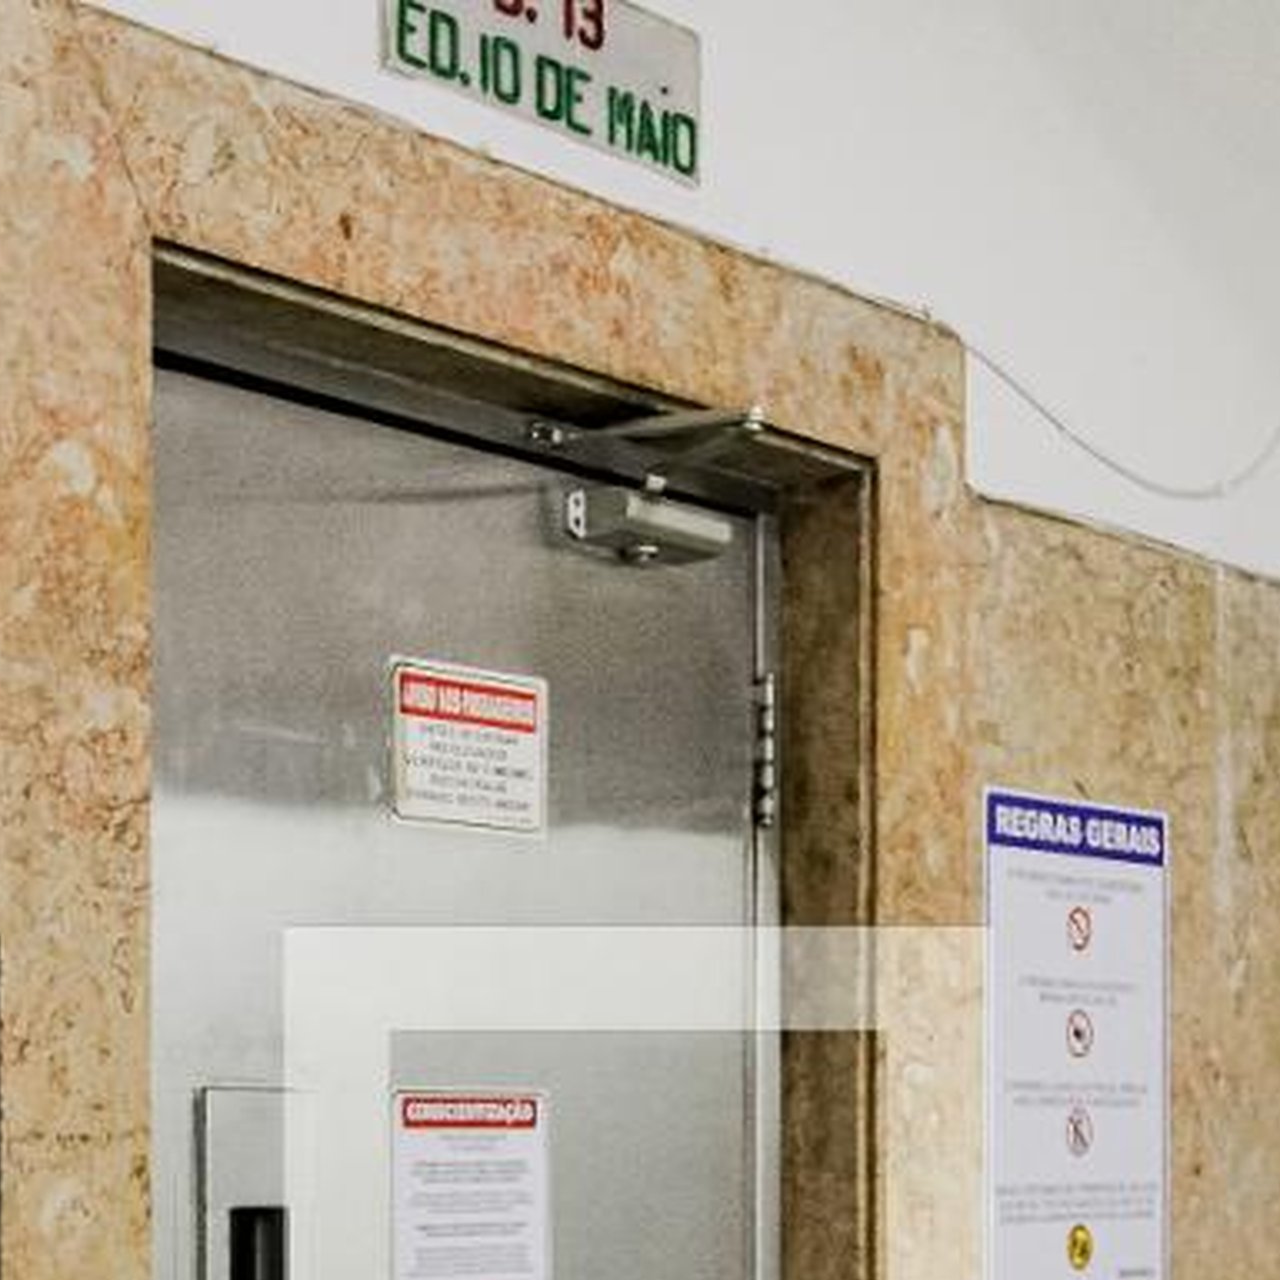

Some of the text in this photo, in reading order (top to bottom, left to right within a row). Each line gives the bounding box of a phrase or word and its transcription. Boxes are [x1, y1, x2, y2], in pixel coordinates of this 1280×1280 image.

[563, 0, 604, 50] 13
[397, 0, 470, 86] ED.
[535, 54, 592, 136] DE
[607, 86, 697, 176] MAIO
[995, 804, 1161, 856] REGRAS GERAIS
